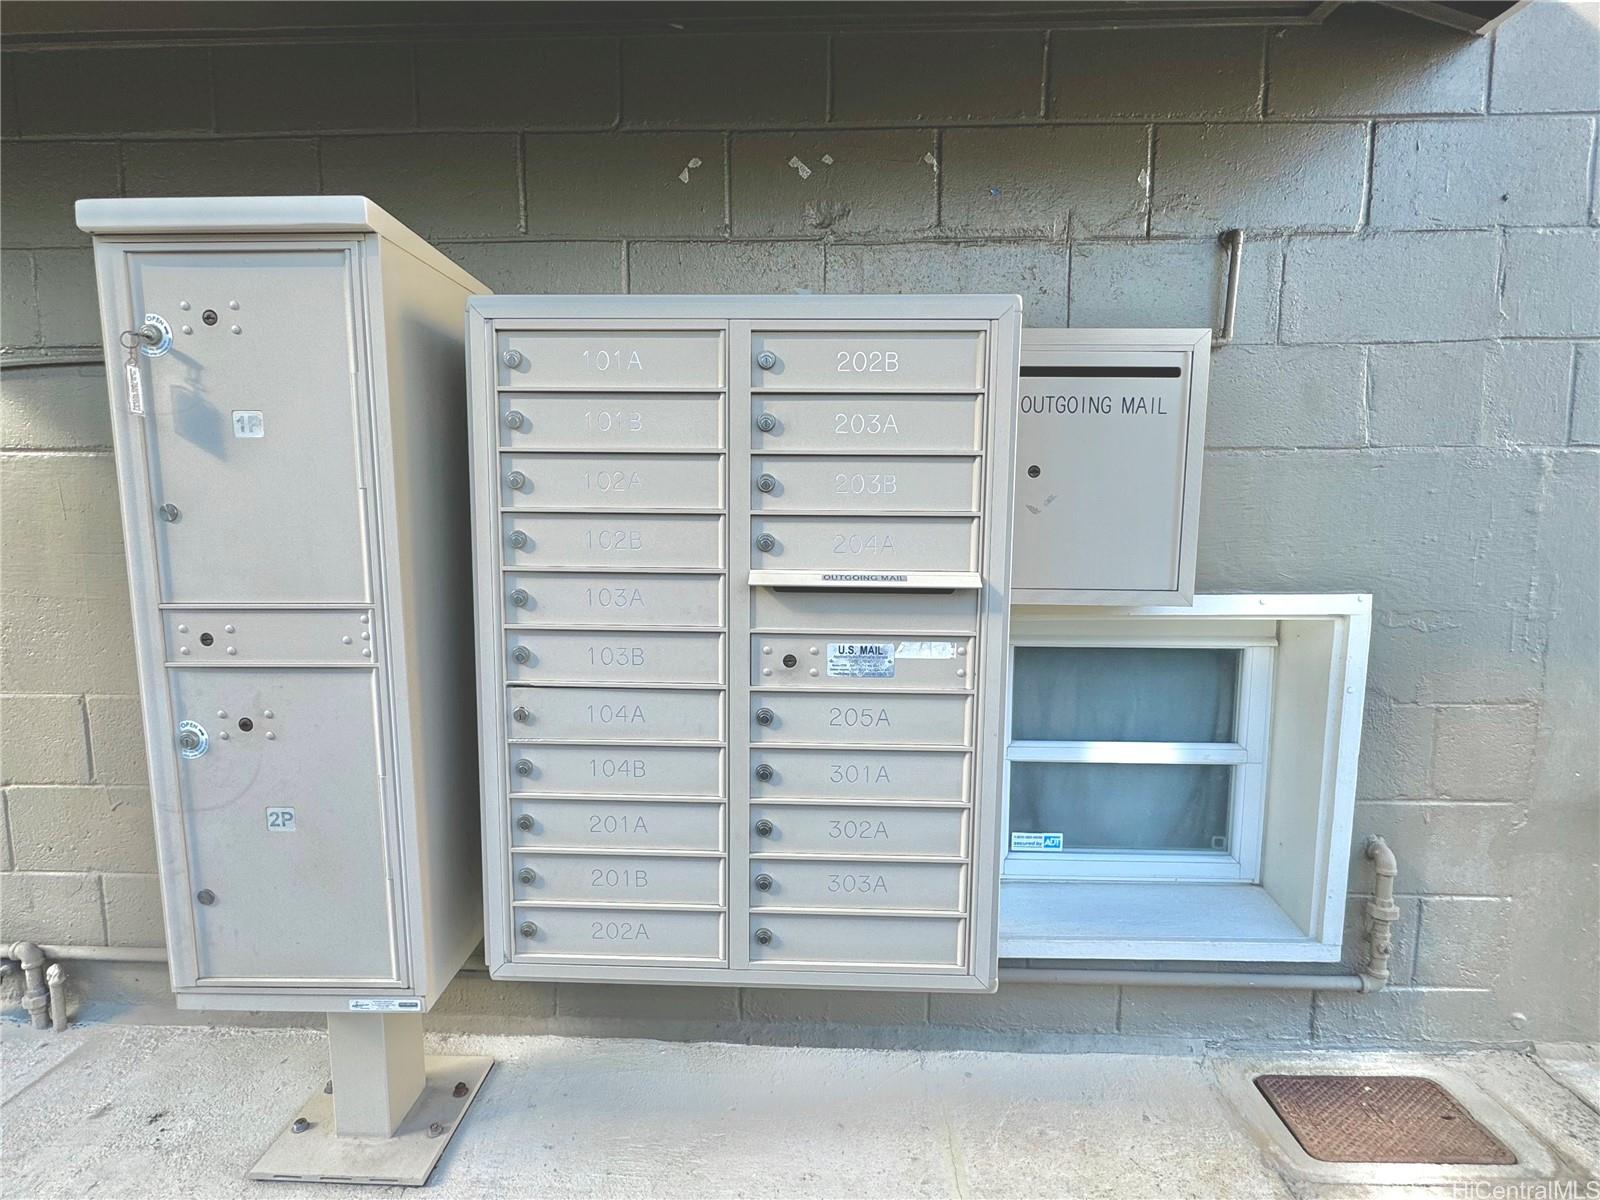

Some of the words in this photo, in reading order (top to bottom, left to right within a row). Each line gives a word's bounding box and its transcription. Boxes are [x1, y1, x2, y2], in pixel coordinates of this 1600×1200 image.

[146, 315, 165, 326] OPEN
[583, 350, 643, 371] 101A
[836, 351, 899, 373] 202B
[1020, 395, 1112, 415] OUTGOING
[1121, 396, 1168, 415] MAIL
[584, 411, 642, 432] 101B
[834, 413, 899, 434] 203A
[584, 471, 641, 492] 102A
[834, 473, 897, 494] 203B
[584, 530, 642, 550] 102B
[832, 534, 895, 554] 204A
[823, 574, 878, 582] OUTGOING
[880, 574, 902, 582] MAIL
[585, 588, 644, 608] 103A
[587, 647, 645, 666] 103B
[838, 645, 857, 655] U.S.
[860, 645, 884, 656] MAIL
[587, 705, 646, 723] 104A
[829, 708, 891, 727] 205A
[180, 722, 198, 730] OPEN
[589, 760, 646, 778] 104B
[829, 765, 890, 783] 301A
[268, 811, 294, 827] 2P
[589, 816, 649, 833] 201A
[828, 821, 889, 839] 302A
[1044, 838, 1061, 846] ADT
[591, 869, 649, 888] 201B
[827, 874, 888, 893] 303A
[591, 923, 650, 940] 202A
